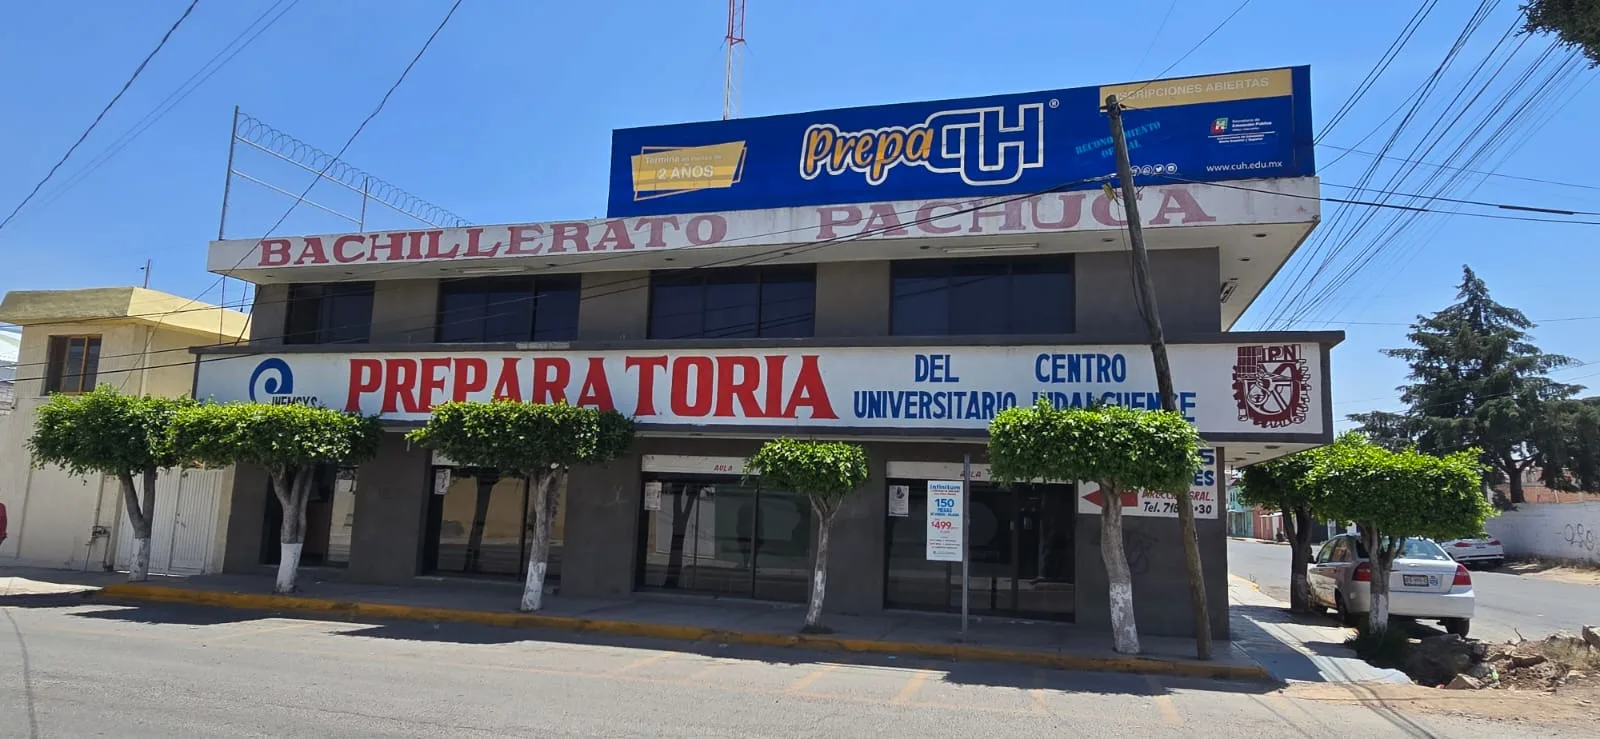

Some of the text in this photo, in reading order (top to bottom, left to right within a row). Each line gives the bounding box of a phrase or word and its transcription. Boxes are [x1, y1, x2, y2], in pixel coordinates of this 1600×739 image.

[1114, 76, 1269, 100] SCRIPCIONES ABIERTAS
[1075, 121, 1161, 155] RECONOMIENTO
[645, 155, 680, 165] Termina
[803, 125, 935, 182] Prepa
[657, 163, 714, 180] 2 AÑOS
[1206, 160, 1283, 172] www.cuh.edu.mx
[258, 187, 1216, 267] BACHILLERATO PACHUCA
[913, 353, 1127, 384] DEL CENTRO
[344, 354, 840, 419] PREPARATORIA
[853, 391, 1017, 420] UNIVERSITARIO
[713, 464, 733, 472] AULA
[960, 470, 982, 478] ALA
[934, 498, 955, 507] 150
[1143, 501, 1161, 513] Tel.
